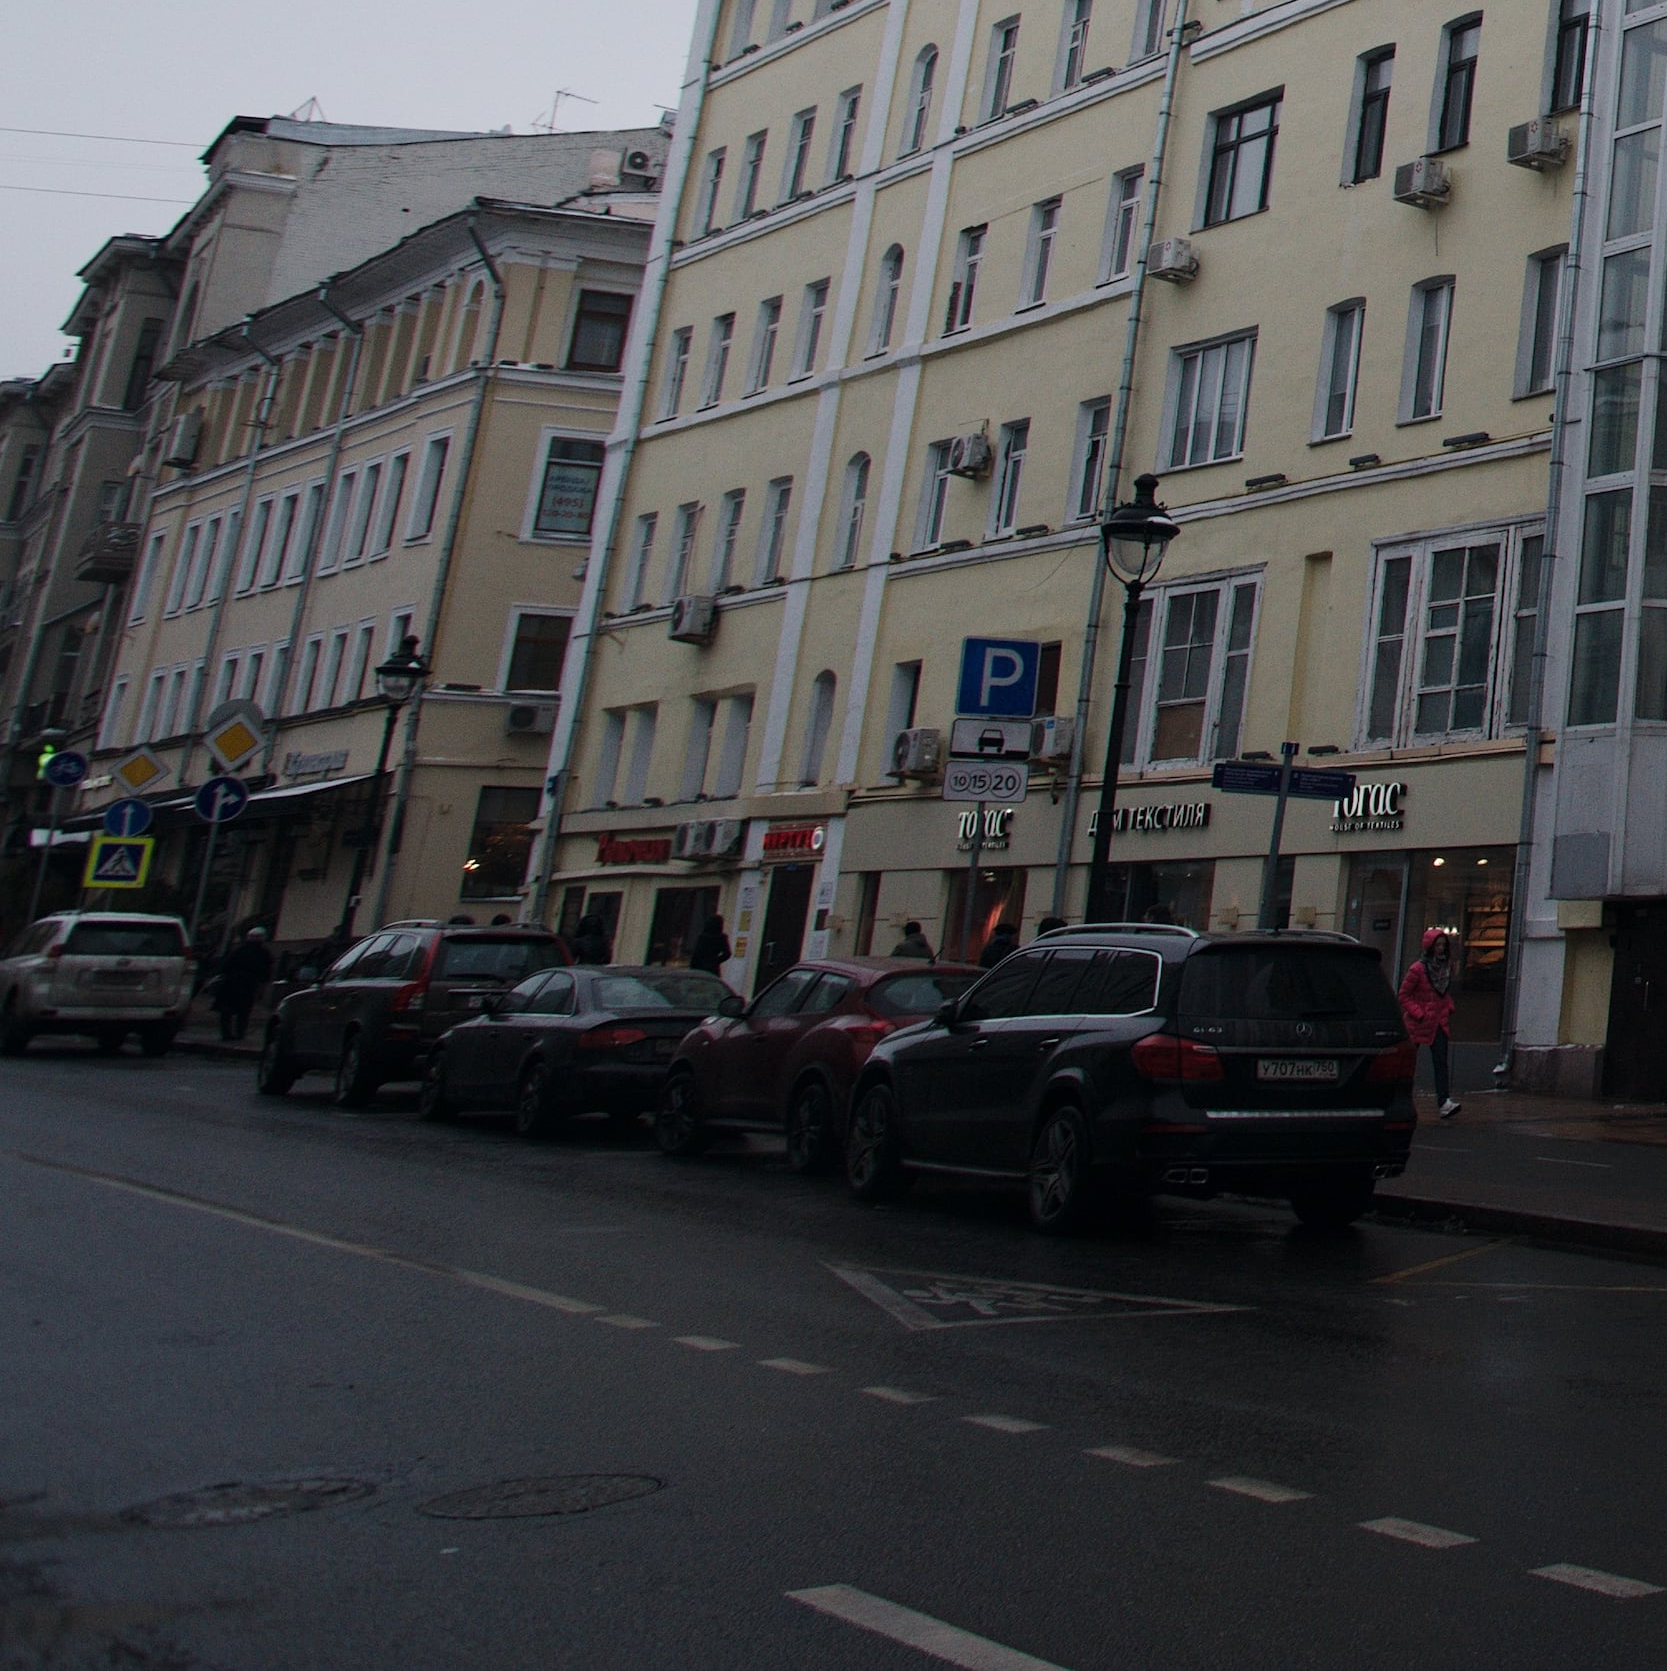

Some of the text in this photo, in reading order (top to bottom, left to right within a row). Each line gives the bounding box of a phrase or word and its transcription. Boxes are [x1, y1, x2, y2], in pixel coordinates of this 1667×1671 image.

[980, 646, 1025, 708] P
[953, 774, 1017, 791] 10 15 20
[1087, 802, 1208, 836] ДМ ТЕКСТИЛЯ
